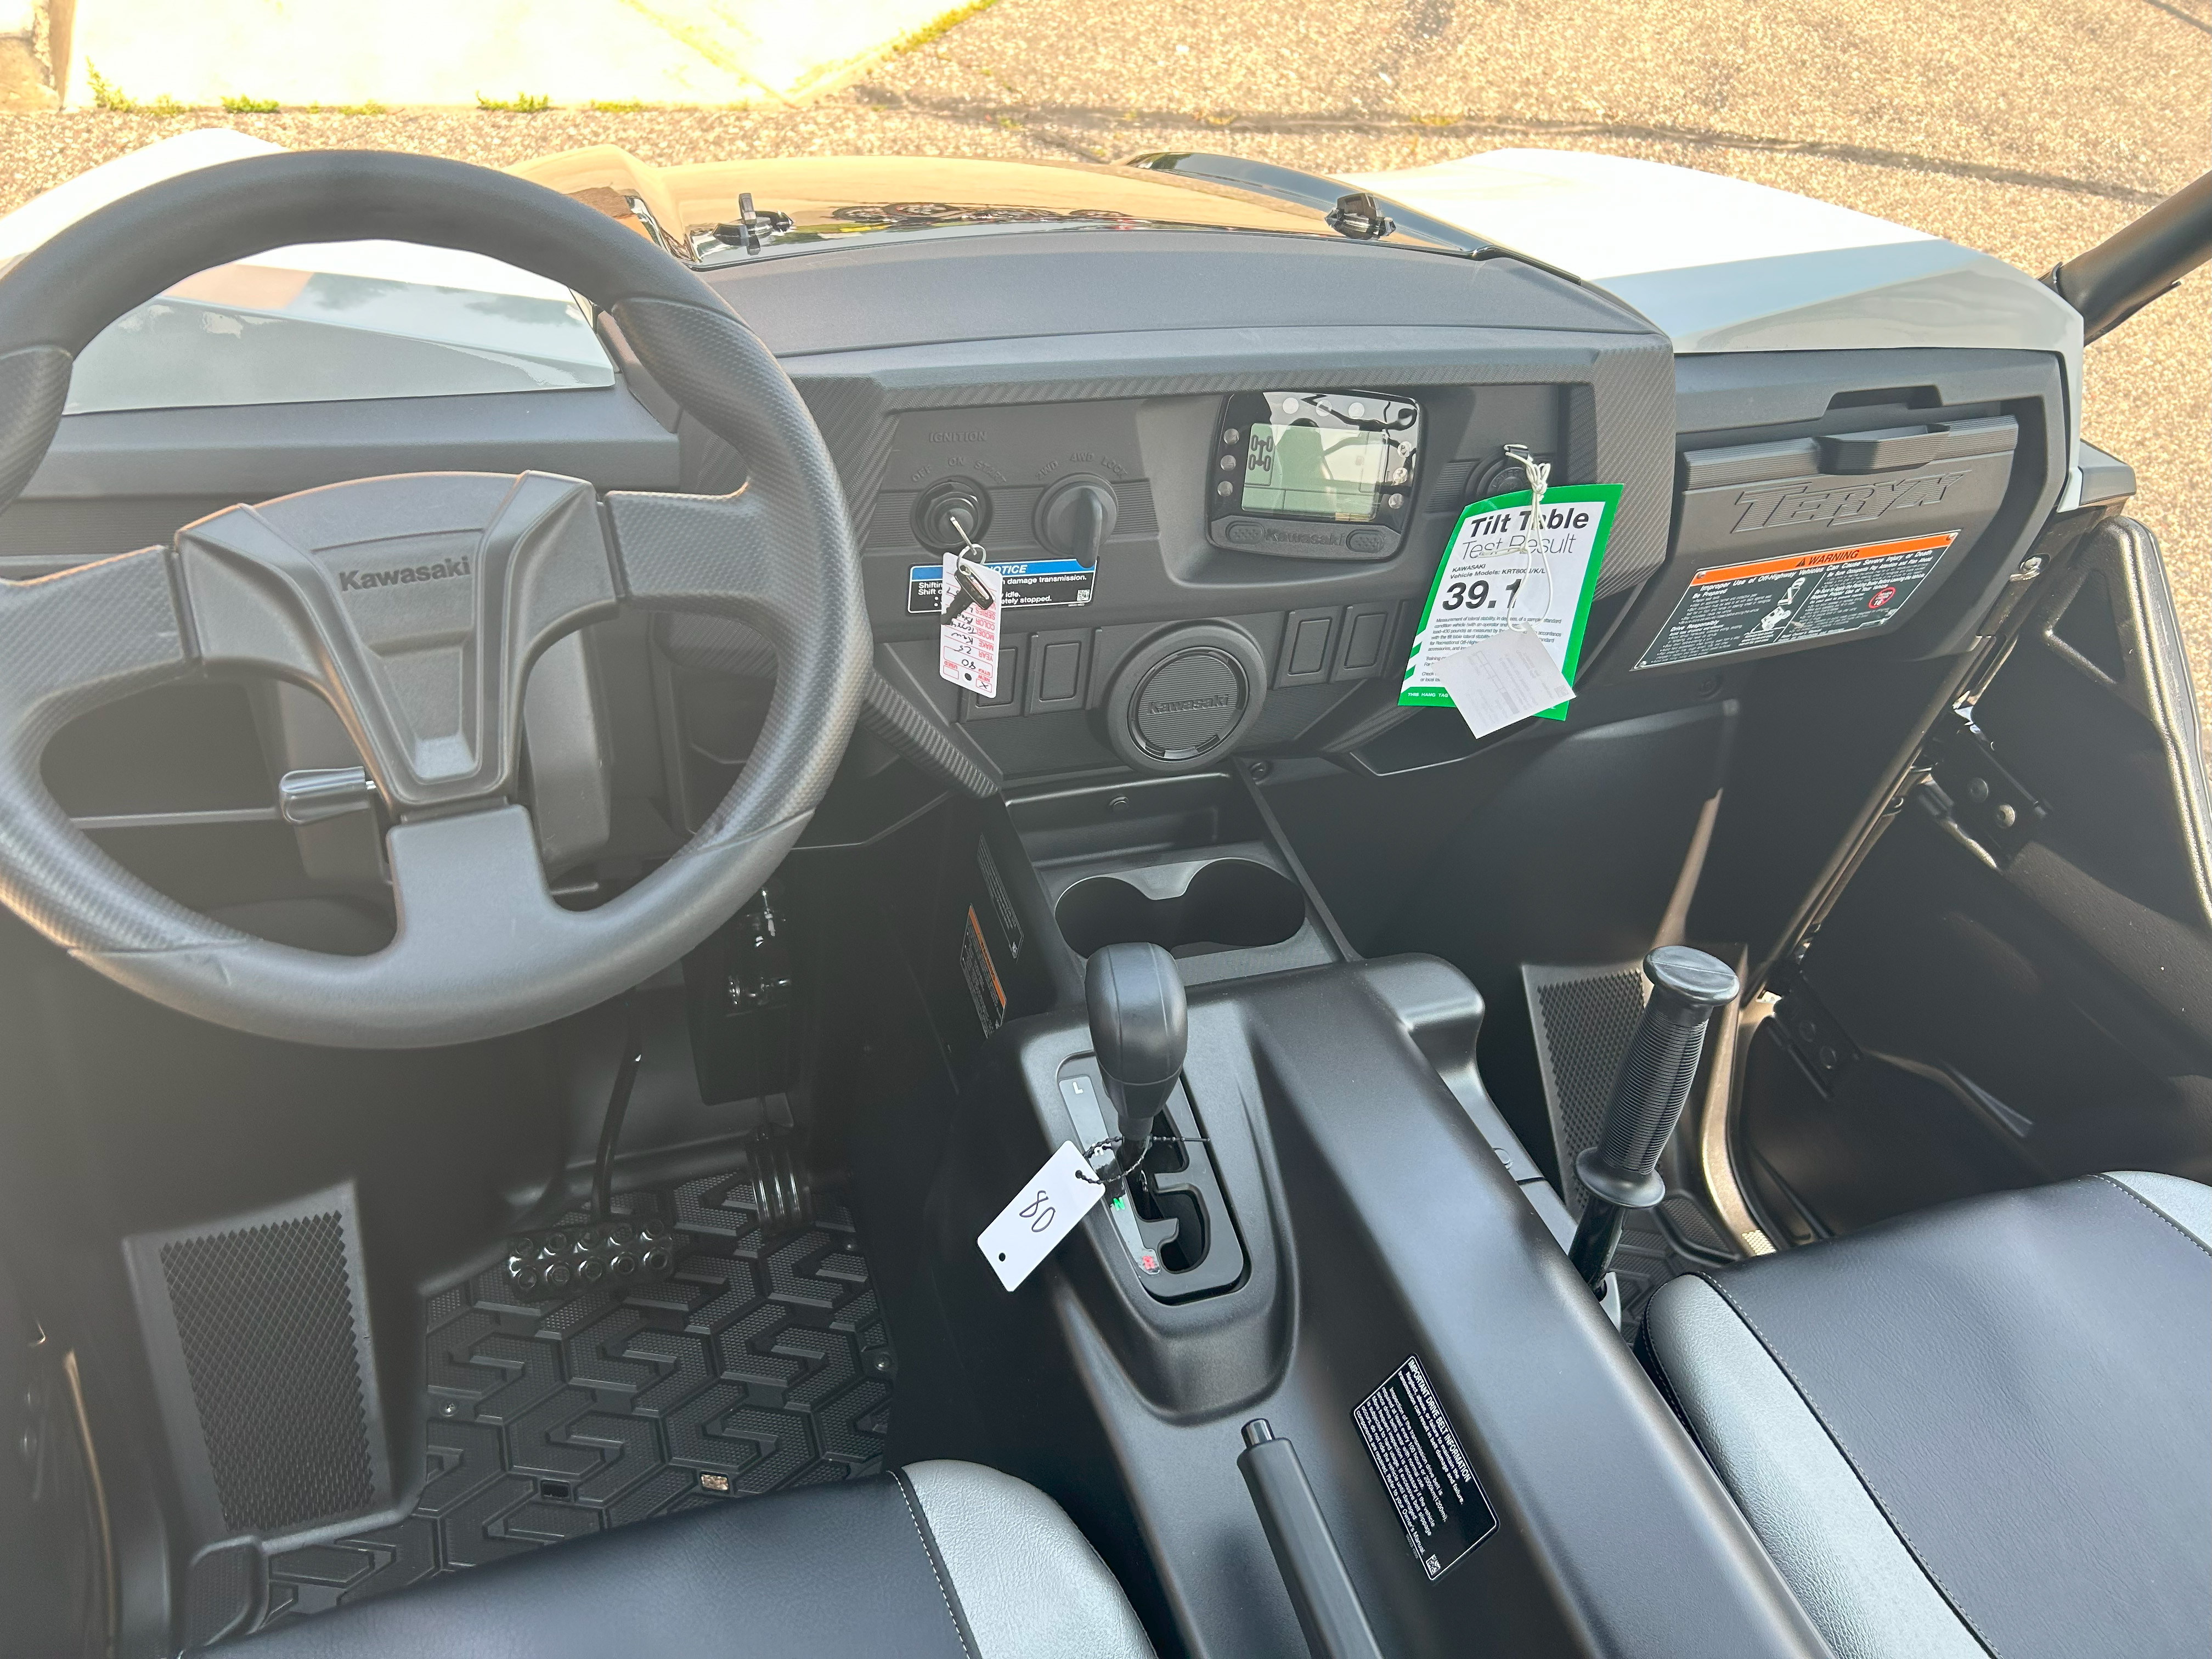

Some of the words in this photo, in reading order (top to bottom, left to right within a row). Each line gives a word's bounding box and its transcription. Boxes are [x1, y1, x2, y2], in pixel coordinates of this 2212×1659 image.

[929, 431, 987, 443] IGNITION
[911, 465, 932, 482] OFF
[948, 457, 965, 466] ON
[974, 460, 1007, 483] START
[1035, 460, 1059, 481] 2WD
[1070, 452, 1094, 462] 4WD
[1100, 456, 1128, 479] LOCK
[1471, 514, 1510, 537] Tilt
[1266, 528, 1346, 546] Kawasaki
[1463, 538, 1502, 559] Test
[1508, 533, 1575, 554] Result
[1452, 563, 1486, 572] KAWASAKI
[1809, 550, 1859, 565] WARNING
[339, 556, 471, 592] Kawasaki
[1039, 574, 1087, 584] transmission.
[1700, 582, 1731, 591] Improper
[1758, 571, 1796, 582] Off-Highway
[1798, 567, 1824, 575] Vehicles
[1914, 549, 1932, 557] Death
[1019, 595, 1052, 604] stopped.
[1442, 579, 1520, 610] 39.1
[1702, 588, 1728, 597] Prepared
[975, 607, 996, 620] SERIES
[976, 618, 995, 630] COLOR
[1686, 619, 1719, 629] Responsibly
[977, 630, 994, 641] MODEL
[978, 640, 994, 651] MAKE
[944, 661, 958, 670] USED
[978, 650, 993, 661] YEAR
[1147, 693, 1229, 714] Kawasaki
[1073, 1081, 1084, 1094] L
[1113, 1198, 1125, 1211] N
[1381, 1386, 1394, 1408] required
[1394, 1413, 1403, 1427] least
[1401, 1427, 1410, 1442] every
[1413, 1452, 1423, 1469] hours
[1405, 1371, 1418, 1395] Neglect,
[1416, 1394, 1426, 1413] abuse,
[1429, 1419, 1439, 1437] failure
[1437, 1436, 1442, 1444] to
[1440, 1444, 1454, 1469] maintain
[1408, 1359, 1430, 1397] IMPORTANT
[1425, 1396, 1440, 1418] DRIVE
[1435, 1416, 1448, 1435] BELT
[1444, 1434, 1471, 1481] INFORMATION
[1376, 1391, 1385, 1406] since
[1383, 1405, 1391, 1419] drive
[1389, 1418, 1398, 1432] belts
[1396, 1432, 1404, 1445] wear
[1408, 1458, 1419, 1477] normal
[1389, 1386, 1404, 1414] Inspection
[1409, 1429, 1427, 1464] transmission
[1425, 1464, 1434, 1478] drive
[1432, 1477, 1440, 1489] belt
[1398, 1370, 1415, 1405] transmission
[1419, 1415, 1429, 1432] result
[1430, 1437, 1438, 1449] belt
[1435, 1449, 1448, 1472] damage
[1447, 1472, 1455, 1484] and
[1452, 1483, 1463, 1504] failure.
[1369, 1406, 1383, 1431] subjected
[1384, 1437, 1392, 1451] hard
[1389, 1450, 1399, 1469] usage.
[1400, 1473, 1415, 1500] excessive
[1418, 1511, 1431, 1536] slippage
[1370, 1424, 1375, 1432] do
[1387, 1462, 1398, 1481] vehicle
[1396, 1481, 1405, 1494] until
[1402, 1494, 1417, 1520] damaged
[1372, 1395, 1380, 1410] More
[1378, 1409, 1390, 1432] frequent
[1388, 1430, 1403, 1459] inspection
[1403, 1464, 1418, 1492] necessary
[1424, 1506, 1435, 1527] vehicle
[1356, 1410, 1373, 1442] components
[1375, 1451, 1388, 1474] repaired.
[1386, 1473, 1395, 1489] Refer
[1395, 1495, 1404, 1508] your
[1402, 1508, 1414, 1532] Owner's
[1412, 1531, 1425, 1555] Manual.
